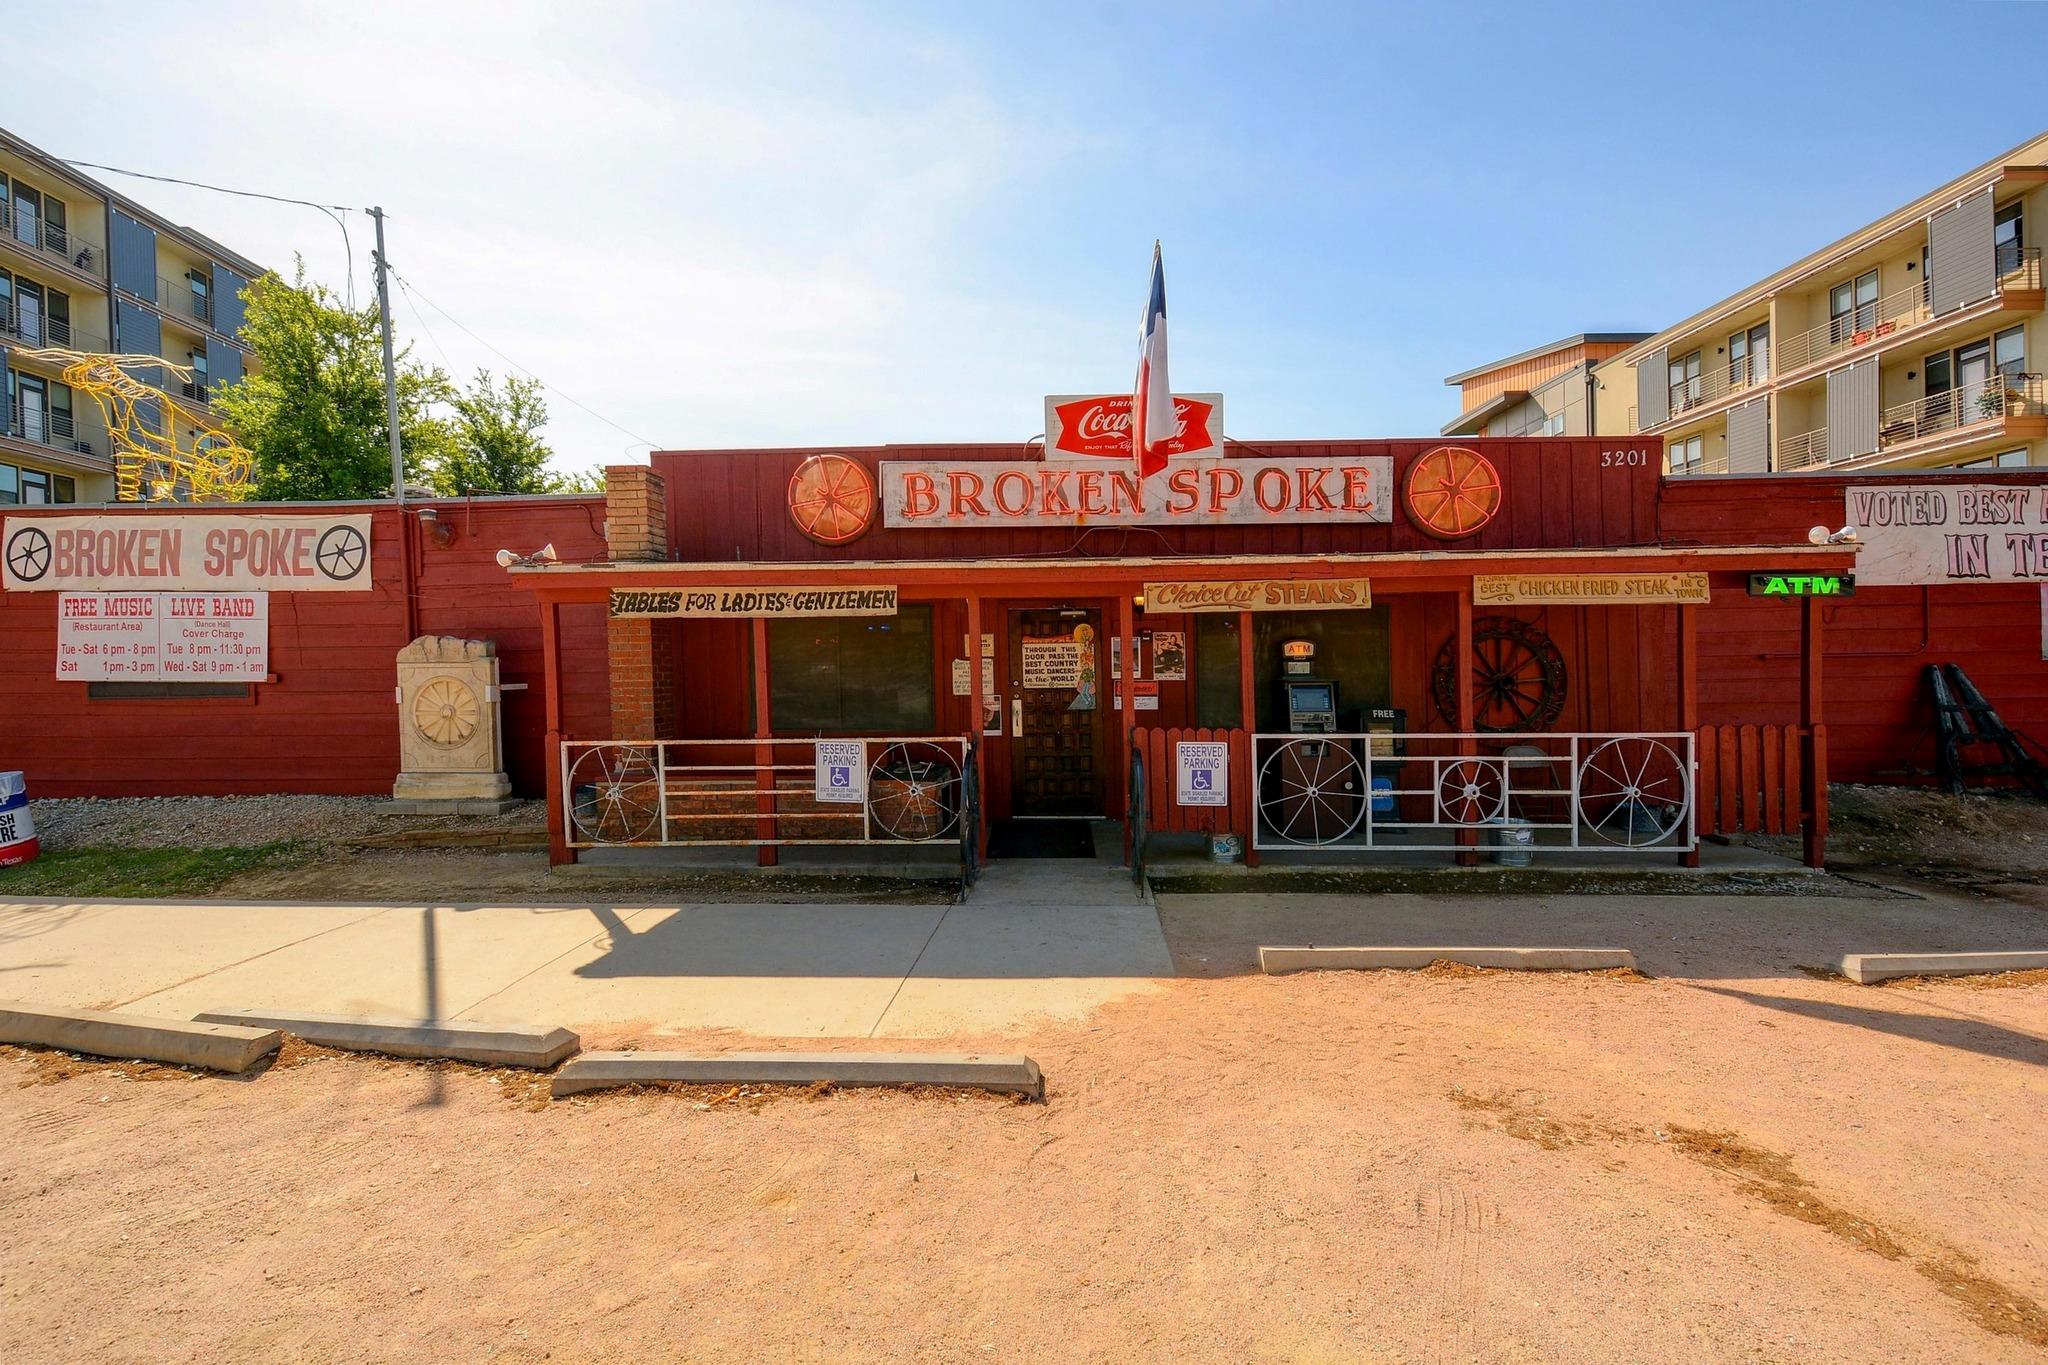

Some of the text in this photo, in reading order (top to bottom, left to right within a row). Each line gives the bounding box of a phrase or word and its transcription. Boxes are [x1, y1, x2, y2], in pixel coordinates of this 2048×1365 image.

[1601, 450, 1647, 467] 3201
[901, 466, 1374, 517] BROKEN SPOKE
[1853, 490, 1947, 527] VOTED
[1957, 488, 2029, 525] BEST
[55, 528, 317, 577] BROKEN SPOKE
[1944, 533, 1991, 579] IN
[1480, 583, 1511, 594] BEST
[1519, 579, 1580, 596] CHICKEN
[1583, 579, 1619, 596] FRIED
[1624, 578, 1673, 596] STEAK
[1680, 578, 1692, 588] IN
[1763, 576, 1840, 594] ATM
[1157, 581, 1357, 605] Choice Cut STEAKS
[1673, 588, 1704, 599] TOWN
[64, 597, 153, 617] FREE MUSIC
[171, 597, 255, 617] LIVE BAND
[614, 591, 683, 614] TABLES
[685, 592, 717, 611] FOR
[72, 621, 143, 632] (Restaurant Area)
[182, 628, 244, 641] Cover Charge
[61, 643, 76, 655] Tue
[83, 643, 98, 655] Sat
[102, 643, 109, 655] 6
[110, 646, 125, 657] pm
[133, 643, 139, 655] 8
[141, 646, 156, 657] pm
[167, 643, 184, 655] Tue
[189, 643, 195, 655] 8
[197, 645, 212, 657] pm
[219, 643, 244, 655] 11:30
[246, 646, 261, 657] pm
[1288, 644, 1311, 653] ATM
[1067, 652, 1079, 660] THE
[61, 660, 78, 672] Sat
[131, 660, 138, 672] 3
[140, 663, 155, 674] pm
[164, 660, 184, 672] Wed
[192, 660, 208, 672] Sat
[211, 660, 217, 672] 9
[219, 663, 234, 674] pm
[1372, 709, 1396, 719] FREE
[819, 743, 860, 755] RESERVED
[1180, 746, 1223, 758] RESERVED
[822, 755, 857, 767] PARKING
[1183, 757, 1220, 769] PARKING
